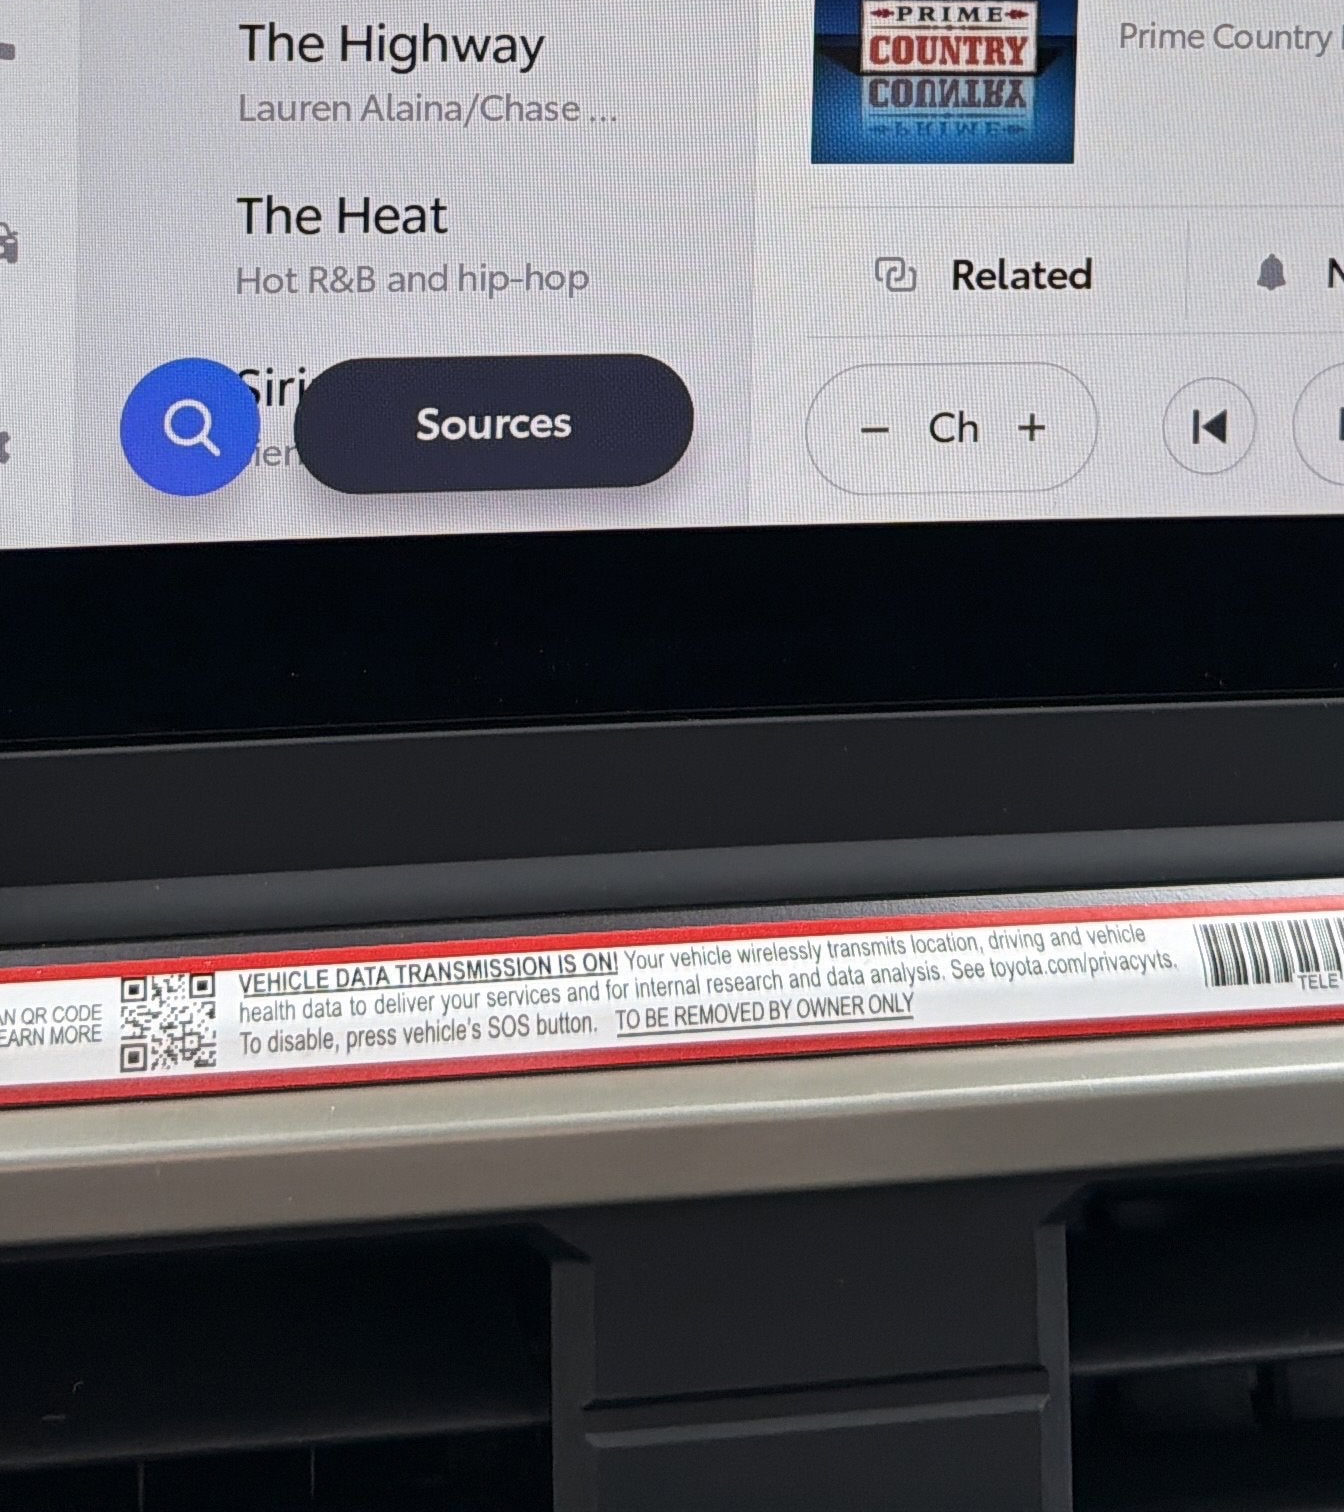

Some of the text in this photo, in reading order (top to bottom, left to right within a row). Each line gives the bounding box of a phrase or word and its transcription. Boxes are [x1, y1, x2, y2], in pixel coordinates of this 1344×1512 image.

[896, 6, 1002, 22] PRIME
[239, 23, 546, 74] The Highway
[869, 35, 1028, 66] COUNTRY
[1119, 22, 1205, 49] Prime
[1213, 23, 1333, 58] Country
[238, 94, 352, 123] Lauren
[359, 94, 581, 127] Alaina/Chase
[237, 196, 448, 236] The Heat
[235, 263, 590, 300] Hot R&B and hip-hop
[951, 258, 1094, 291] Related
[415, 408, 572, 442] Sources
[929, 411, 980, 444] Ch
[239, 924, 1145, 993] VEHICLE DATA TRANSMISSION IS ON! Your vehicle wirelessly transmits location, driving and vehicle
[239, 950, 1178, 1023] health data to deliver your services and for internal research and data analysis. See toyota.com/privacyvts.
[1297, 973, 1340, 990] TELE
[21, 1007, 47, 1025] QR
[52, 1004, 103, 1023] CODE
[240, 992, 914, 1054] To disable, press vehicle's SOS button. TO BE REMOVED BY OWNER ONLY
[50, 1024, 102, 1045] MORE
